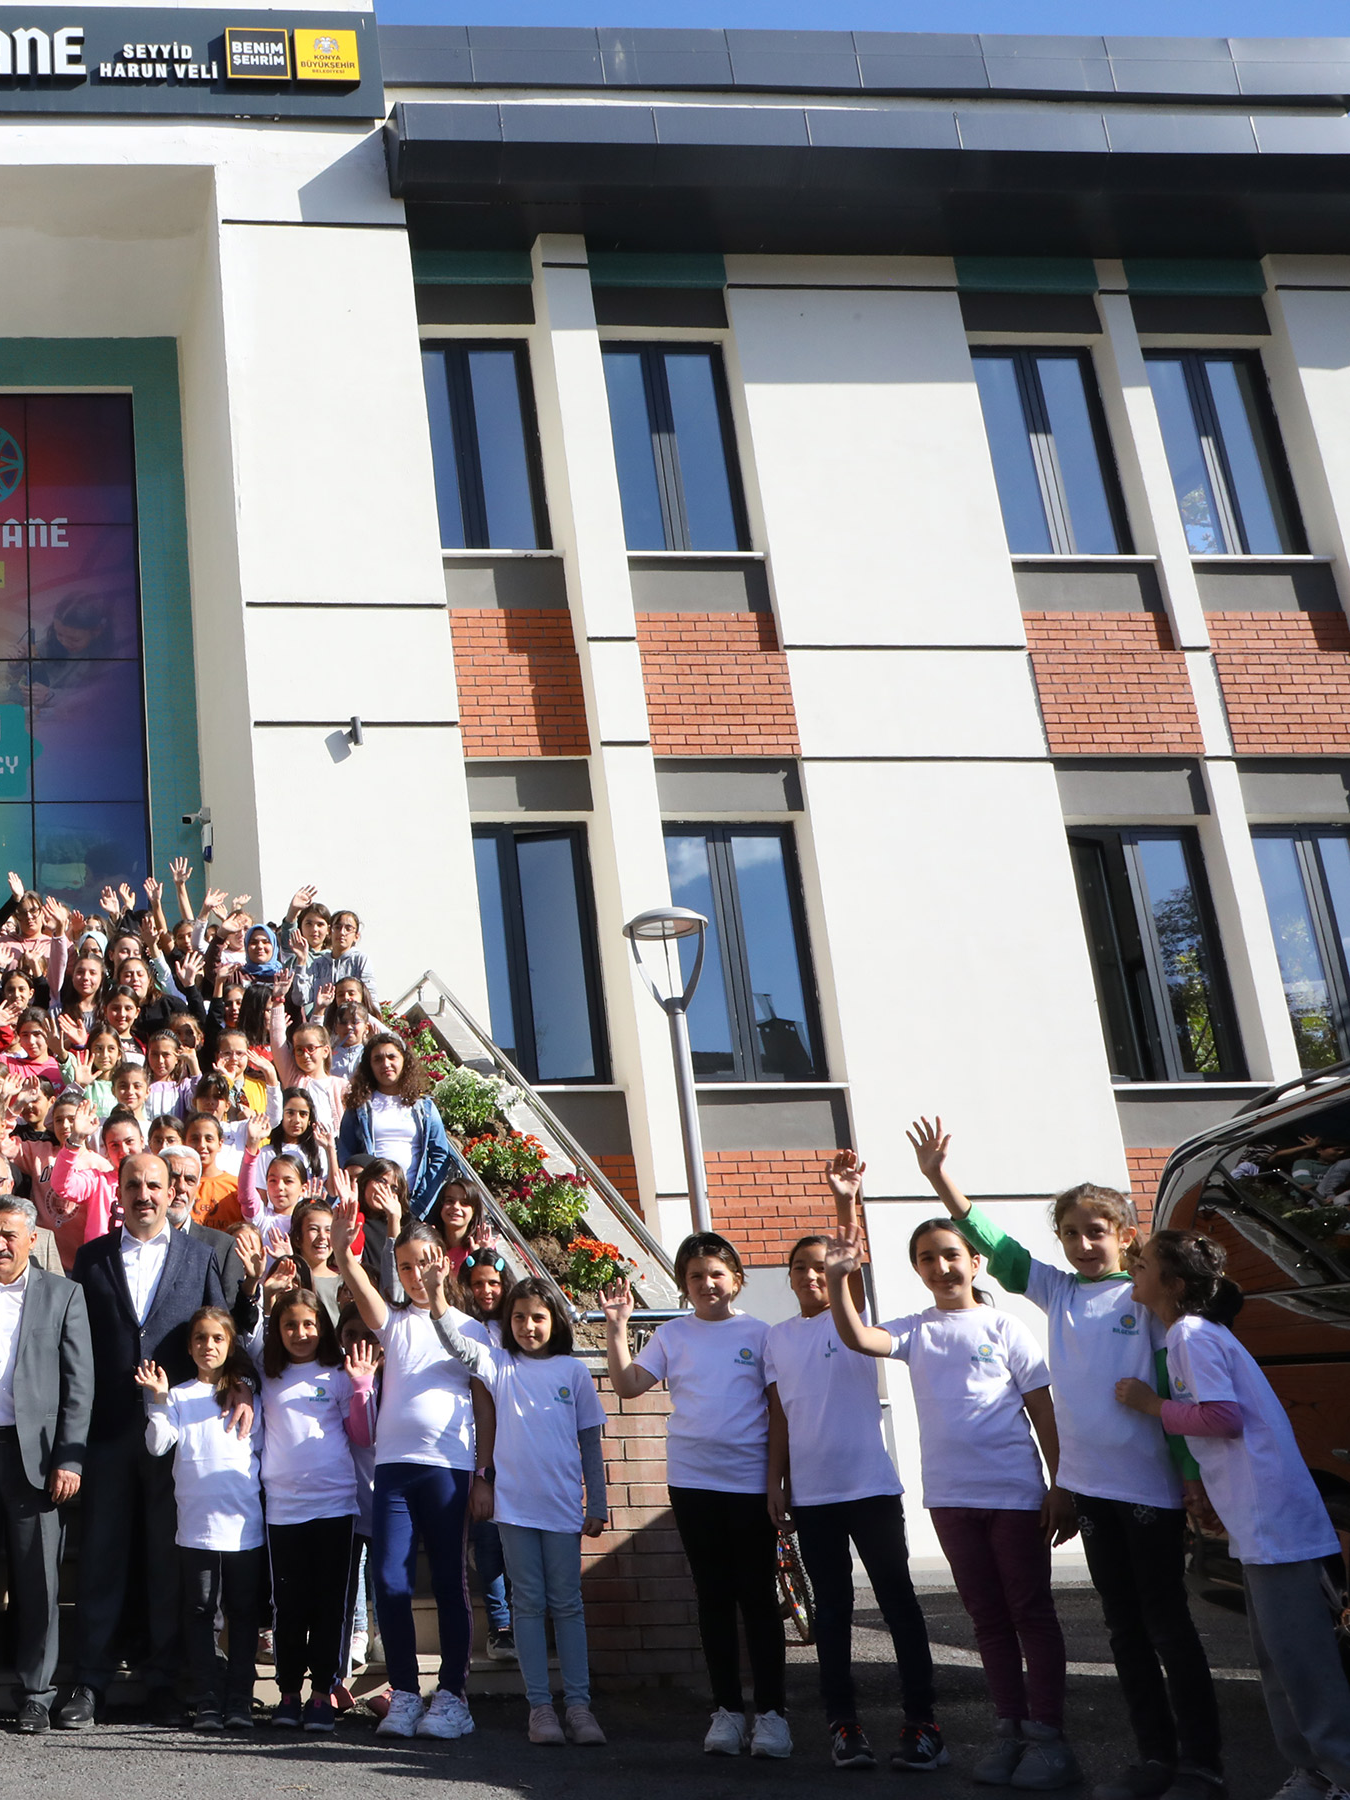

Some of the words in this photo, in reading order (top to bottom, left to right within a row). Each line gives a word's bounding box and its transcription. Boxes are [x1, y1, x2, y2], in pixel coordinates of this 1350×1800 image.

[122, 42, 193, 59] SEYYİD
[233, 53, 285, 66] ŞEHRİM
[99, 62, 168, 78] HARUN
[173, 61, 218, 79] VELİ
